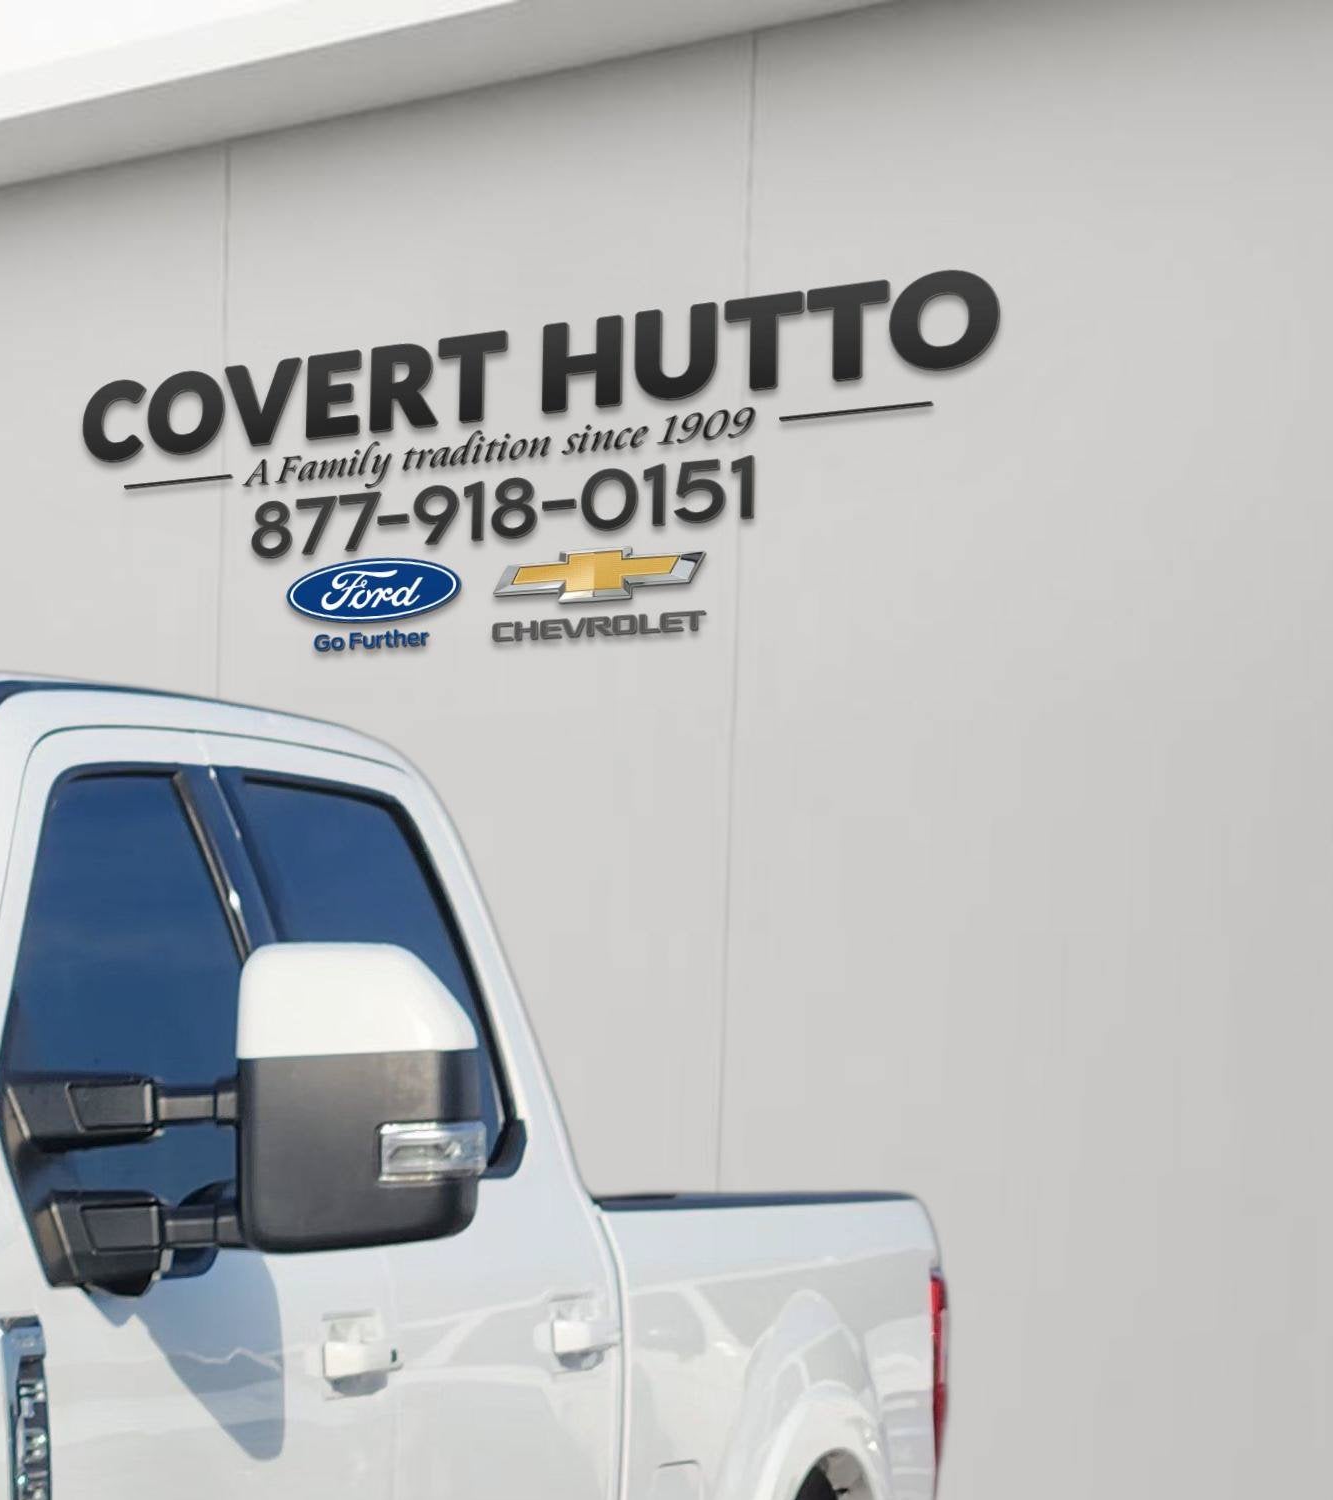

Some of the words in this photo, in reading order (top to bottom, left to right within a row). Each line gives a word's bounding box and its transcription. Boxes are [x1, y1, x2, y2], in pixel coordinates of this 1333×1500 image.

[82, 330, 509, 464] COVERT
[541, 269, 1001, 415] HUTTO
[243, 458, 269, 488] A
[276, 441, 393, 489] Family
[402, 430, 551, 473] tradition
[561, 422, 650, 456] since
[656, 406, 757, 446] 1909
[250, 454, 756, 560] 877-918-0151
[320, 569, 423, 611] Ford
[313, 632, 346, 653] Go
[348, 628, 431, 652] Further
[490, 609, 708, 644] CHEVROLET
